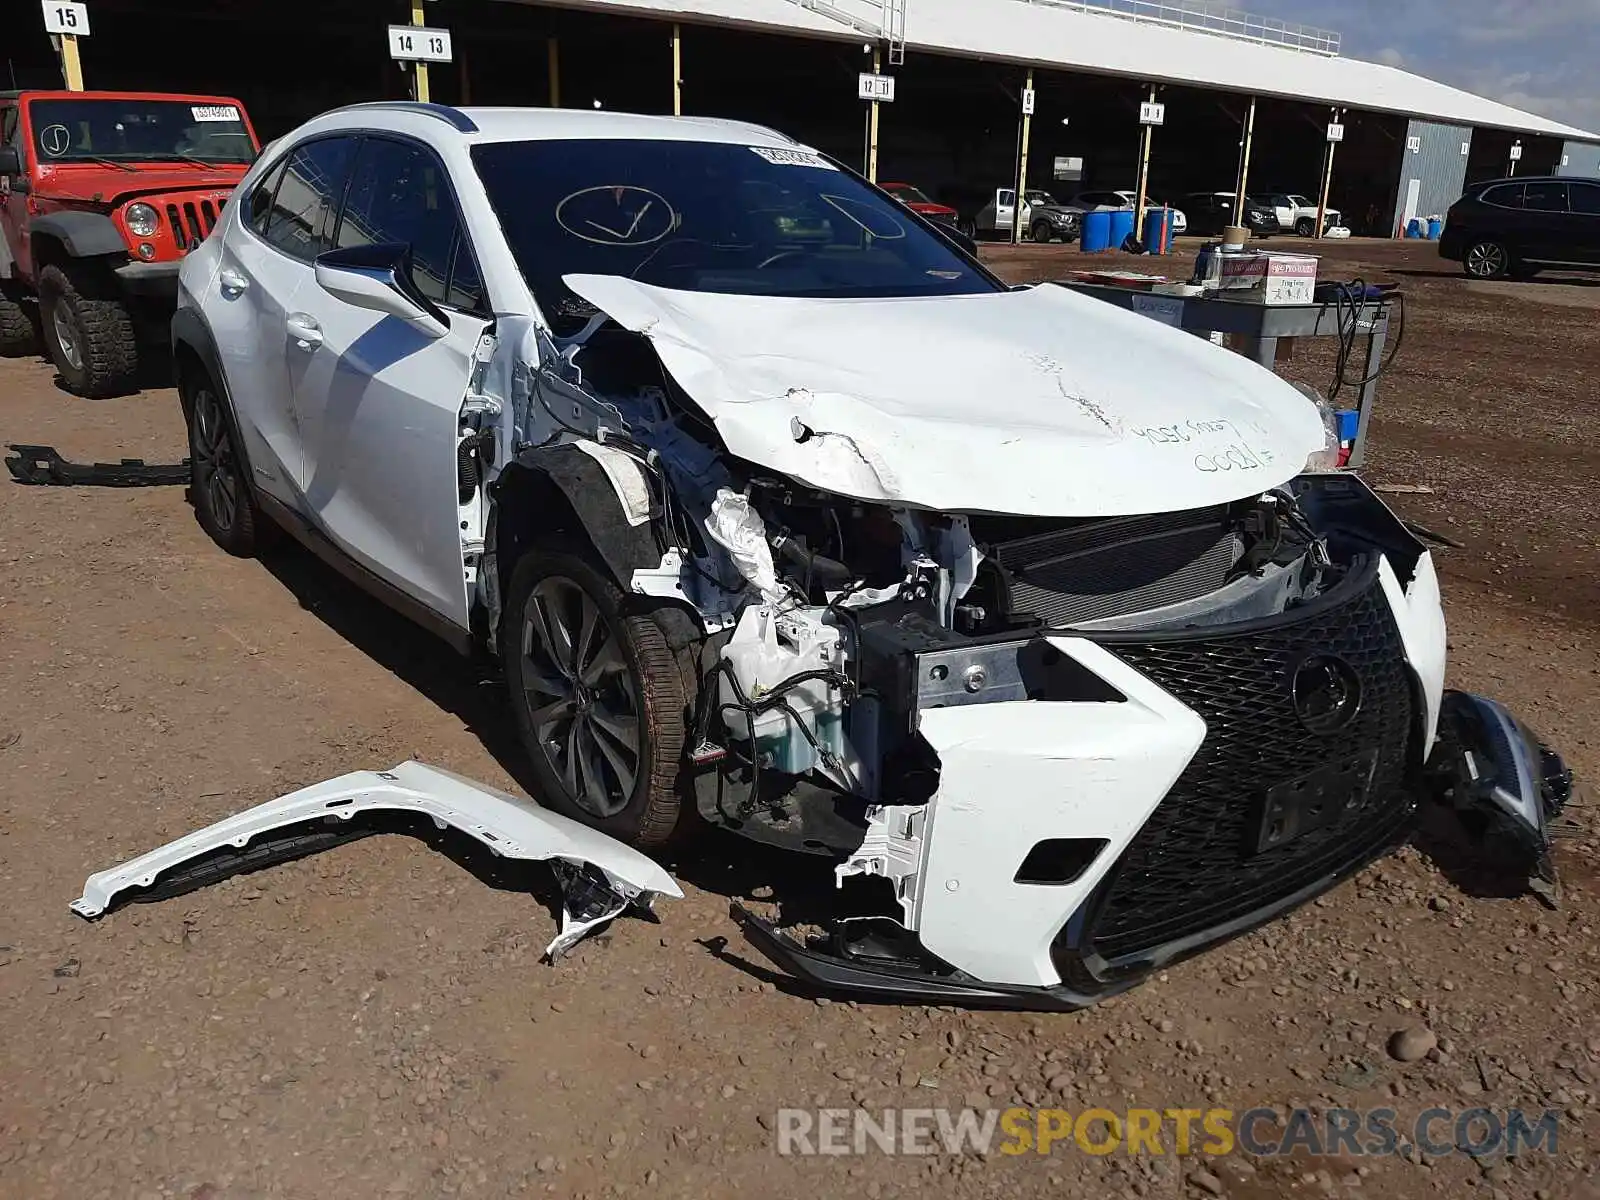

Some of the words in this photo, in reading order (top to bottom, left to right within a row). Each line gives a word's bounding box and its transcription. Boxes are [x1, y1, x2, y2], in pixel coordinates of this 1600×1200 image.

[56, 8, 77, 27] 15
[398, 36, 413, 51] 14
[429, 38, 443, 54] 13
[865, 80, 873, 93] 12
